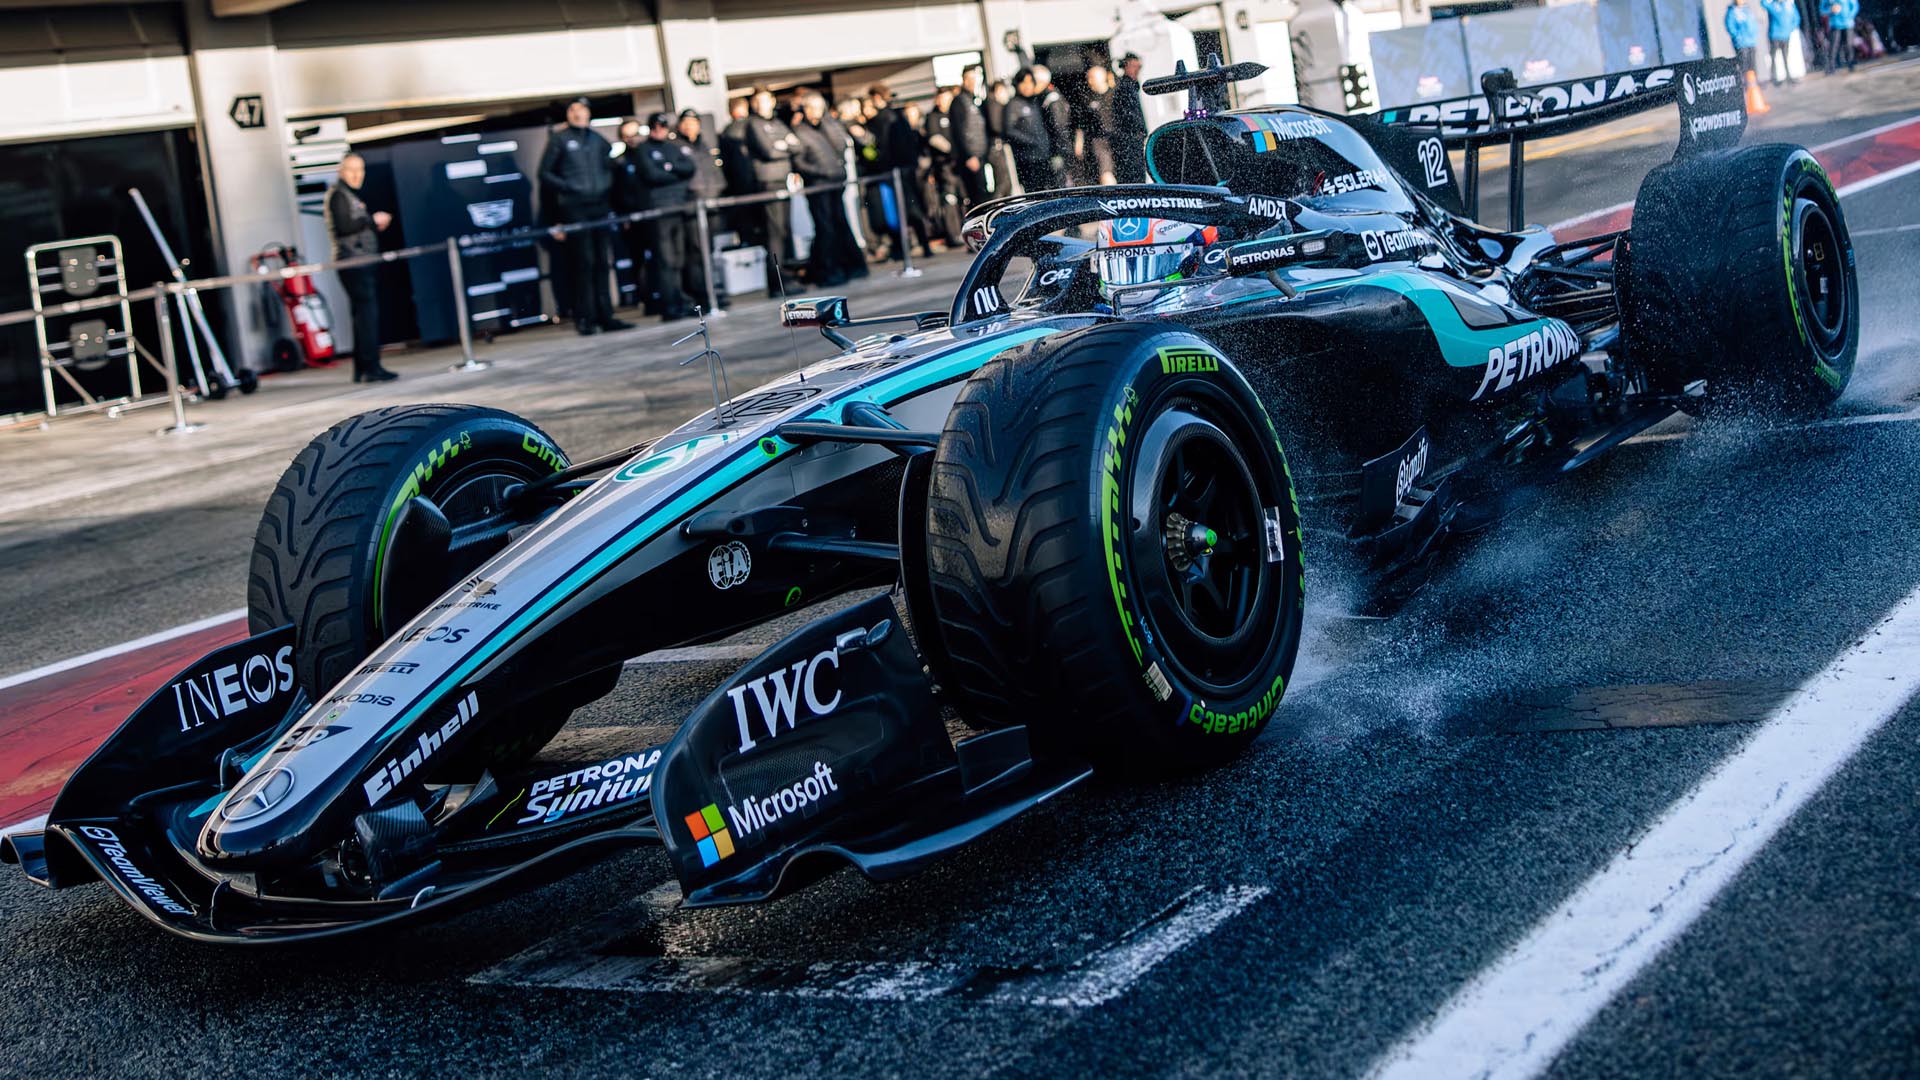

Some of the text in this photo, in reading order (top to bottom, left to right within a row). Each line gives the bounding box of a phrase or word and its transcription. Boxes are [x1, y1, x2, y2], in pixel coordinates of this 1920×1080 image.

[1696, 73, 1737, 97] Snapdragon
[234, 100, 261, 125] 47
[1268, 116, 1333, 142] Microsoft
[1417, 137, 1448, 188] 12
[1106, 198, 1204, 210] CROWDSTRIKE
[1248, 197, 1277, 217] AMD
[1232, 246, 1296, 266] PETRONAS
[1156, 345, 1219, 375] PIRELLI
[172, 645, 294, 732] INEOS
[727, 647, 843, 753] IWC
[1189, 675, 1284, 734] Cinturato
[363, 690, 479, 807] Einhell
[530, 750, 662, 797] PETRONA
[728, 760, 839, 838] Microsoft
[98, 842, 194, 915] TeamViewer
